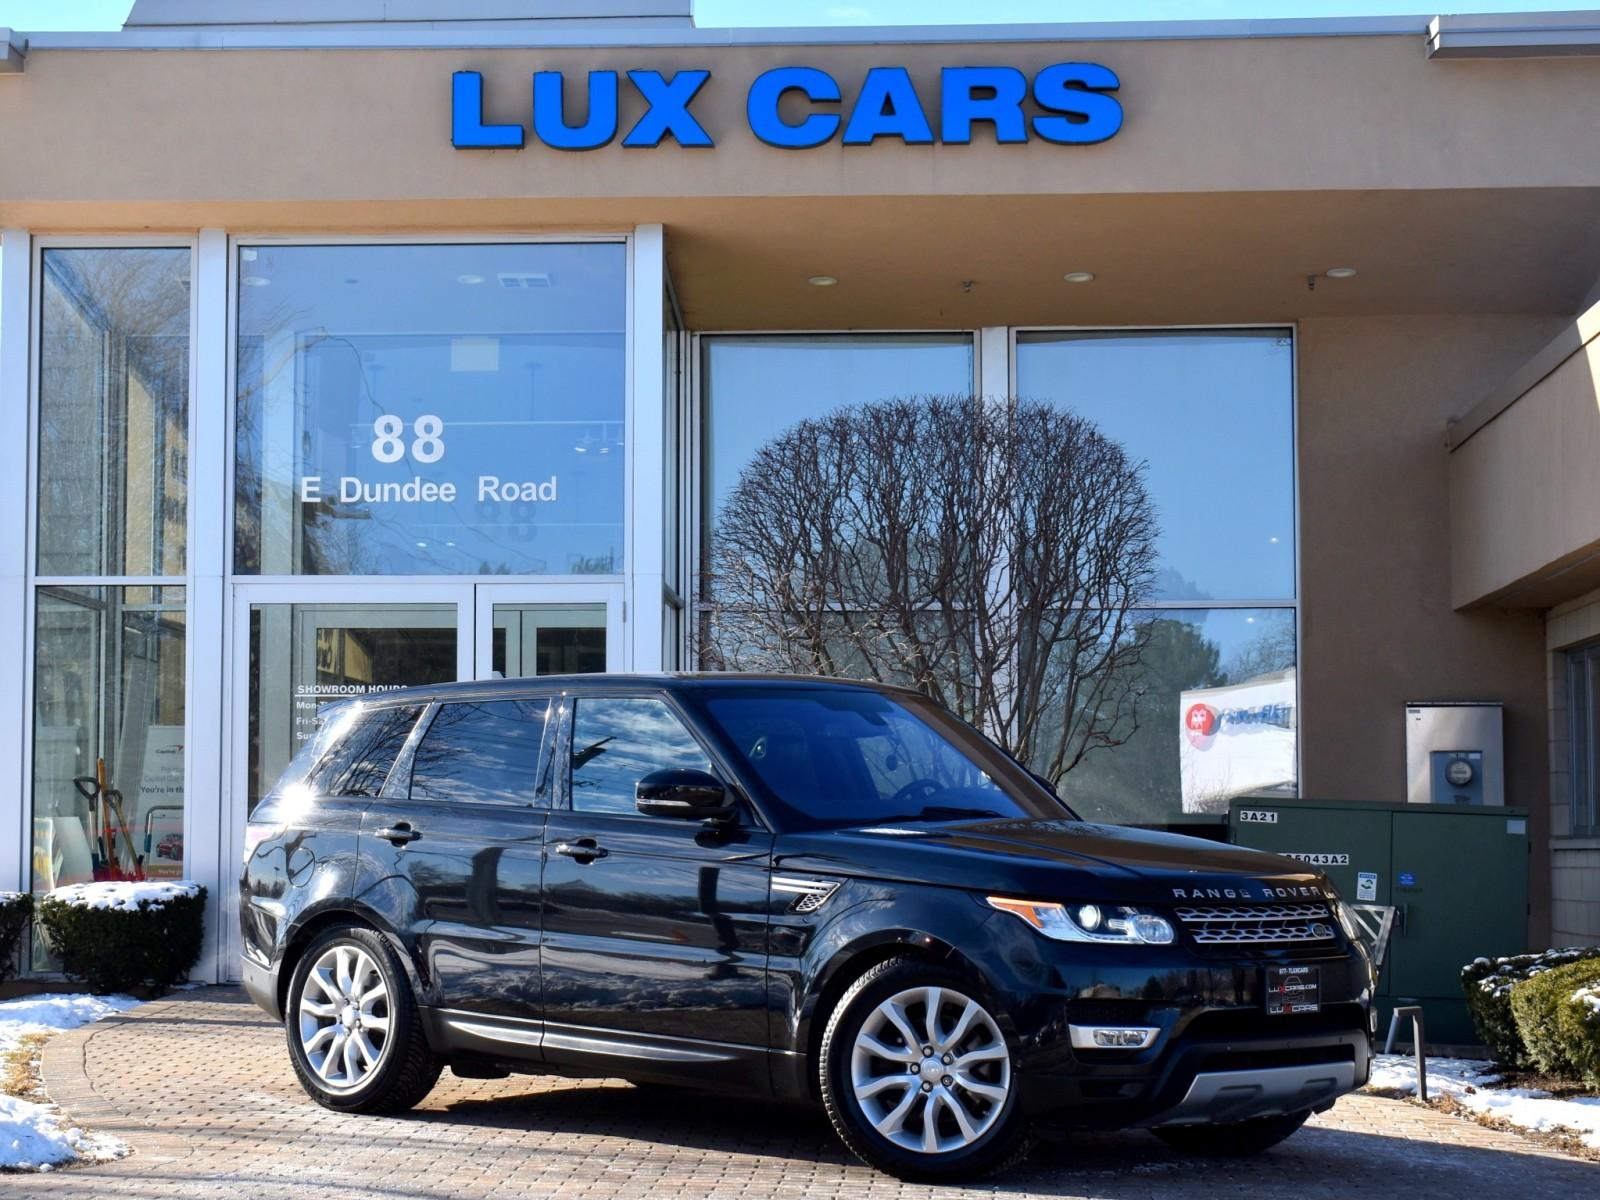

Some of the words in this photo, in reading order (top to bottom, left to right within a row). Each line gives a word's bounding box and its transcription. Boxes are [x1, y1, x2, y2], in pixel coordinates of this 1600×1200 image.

[451, 69, 715, 152] LUX
[746, 62, 1124, 149] CARS
[371, 414, 445, 464] 88
[301, 476, 321, 503] E
[340, 476, 457, 503] Dundee
[478, 475, 558, 502] Road
[297, 684, 366, 694] SHOWROOM
[296, 701, 328, 710] Mon-T
[141, 785, 165, 793] You're
[166, 785, 174, 793] in
[1240, 811, 1277, 823] 3A21
[1172, 888, 1251, 899] RANGE
[1262, 886, 1321, 898] ROVER
